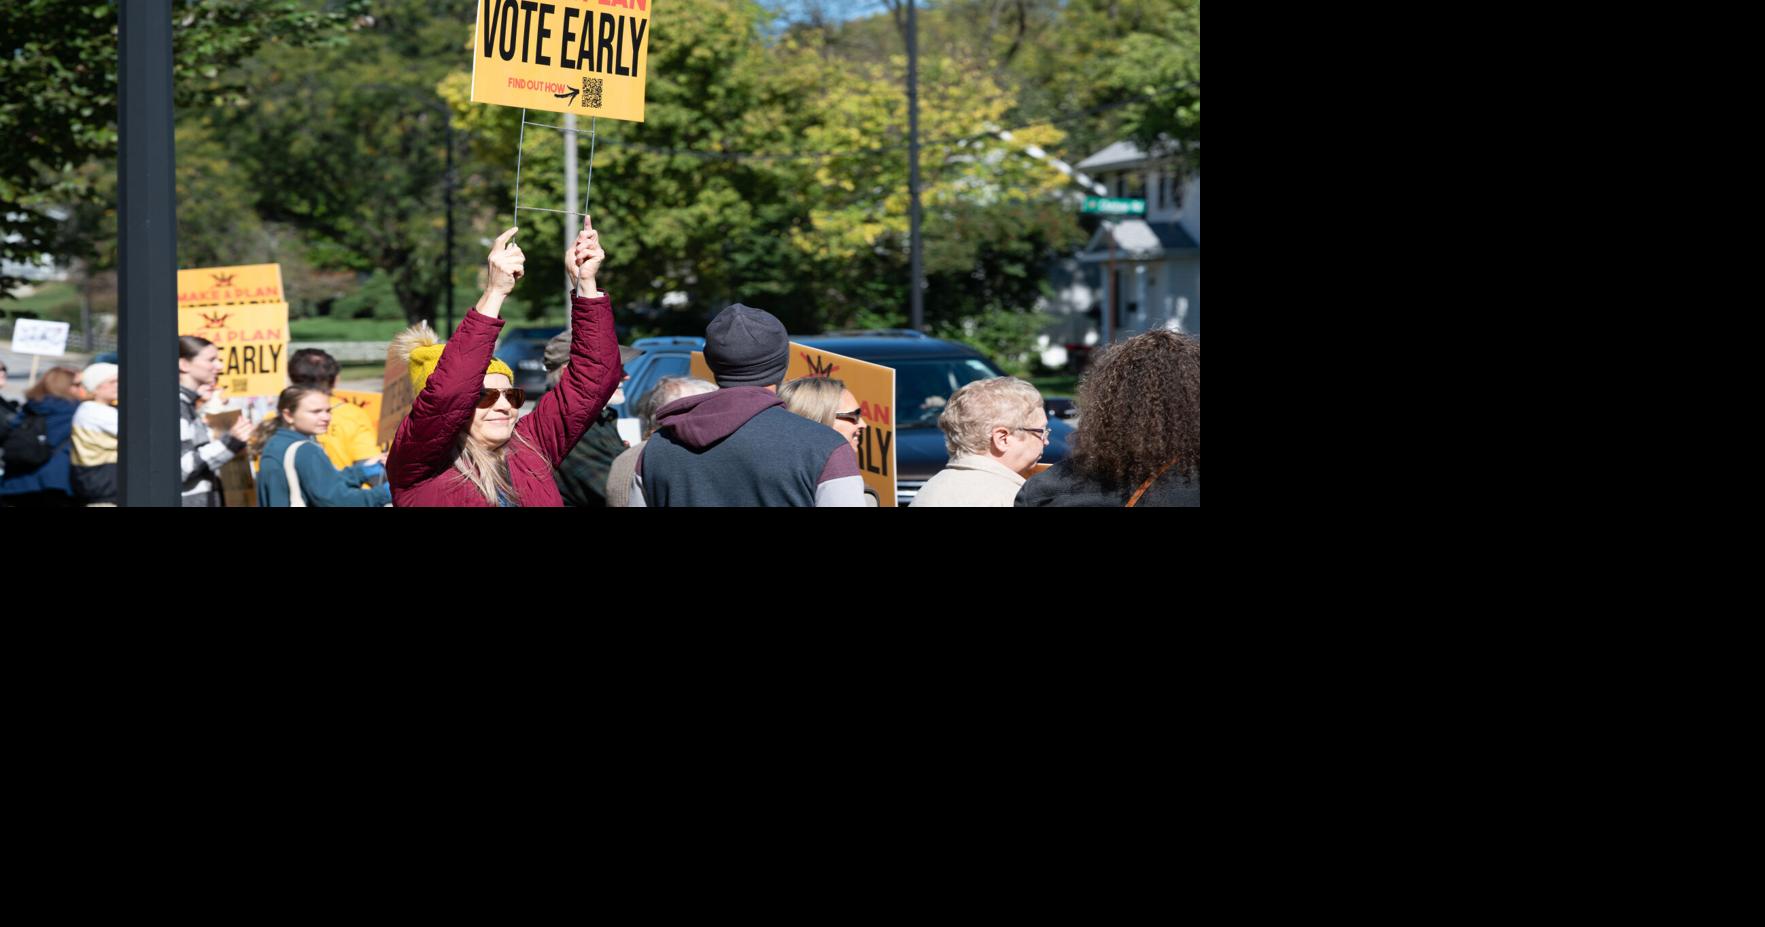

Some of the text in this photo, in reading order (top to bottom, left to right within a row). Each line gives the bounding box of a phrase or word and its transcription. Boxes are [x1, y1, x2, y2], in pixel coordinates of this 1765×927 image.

[484, 0, 647, 77] VOTE EARLY
[508, 77, 566, 93] FIND OUT HOW
[178, 290, 219, 301] MAKE
[235, 287, 278, 297] PLAN
[228, 329, 281, 341] PLAN
[860, 400, 889, 425] AN
